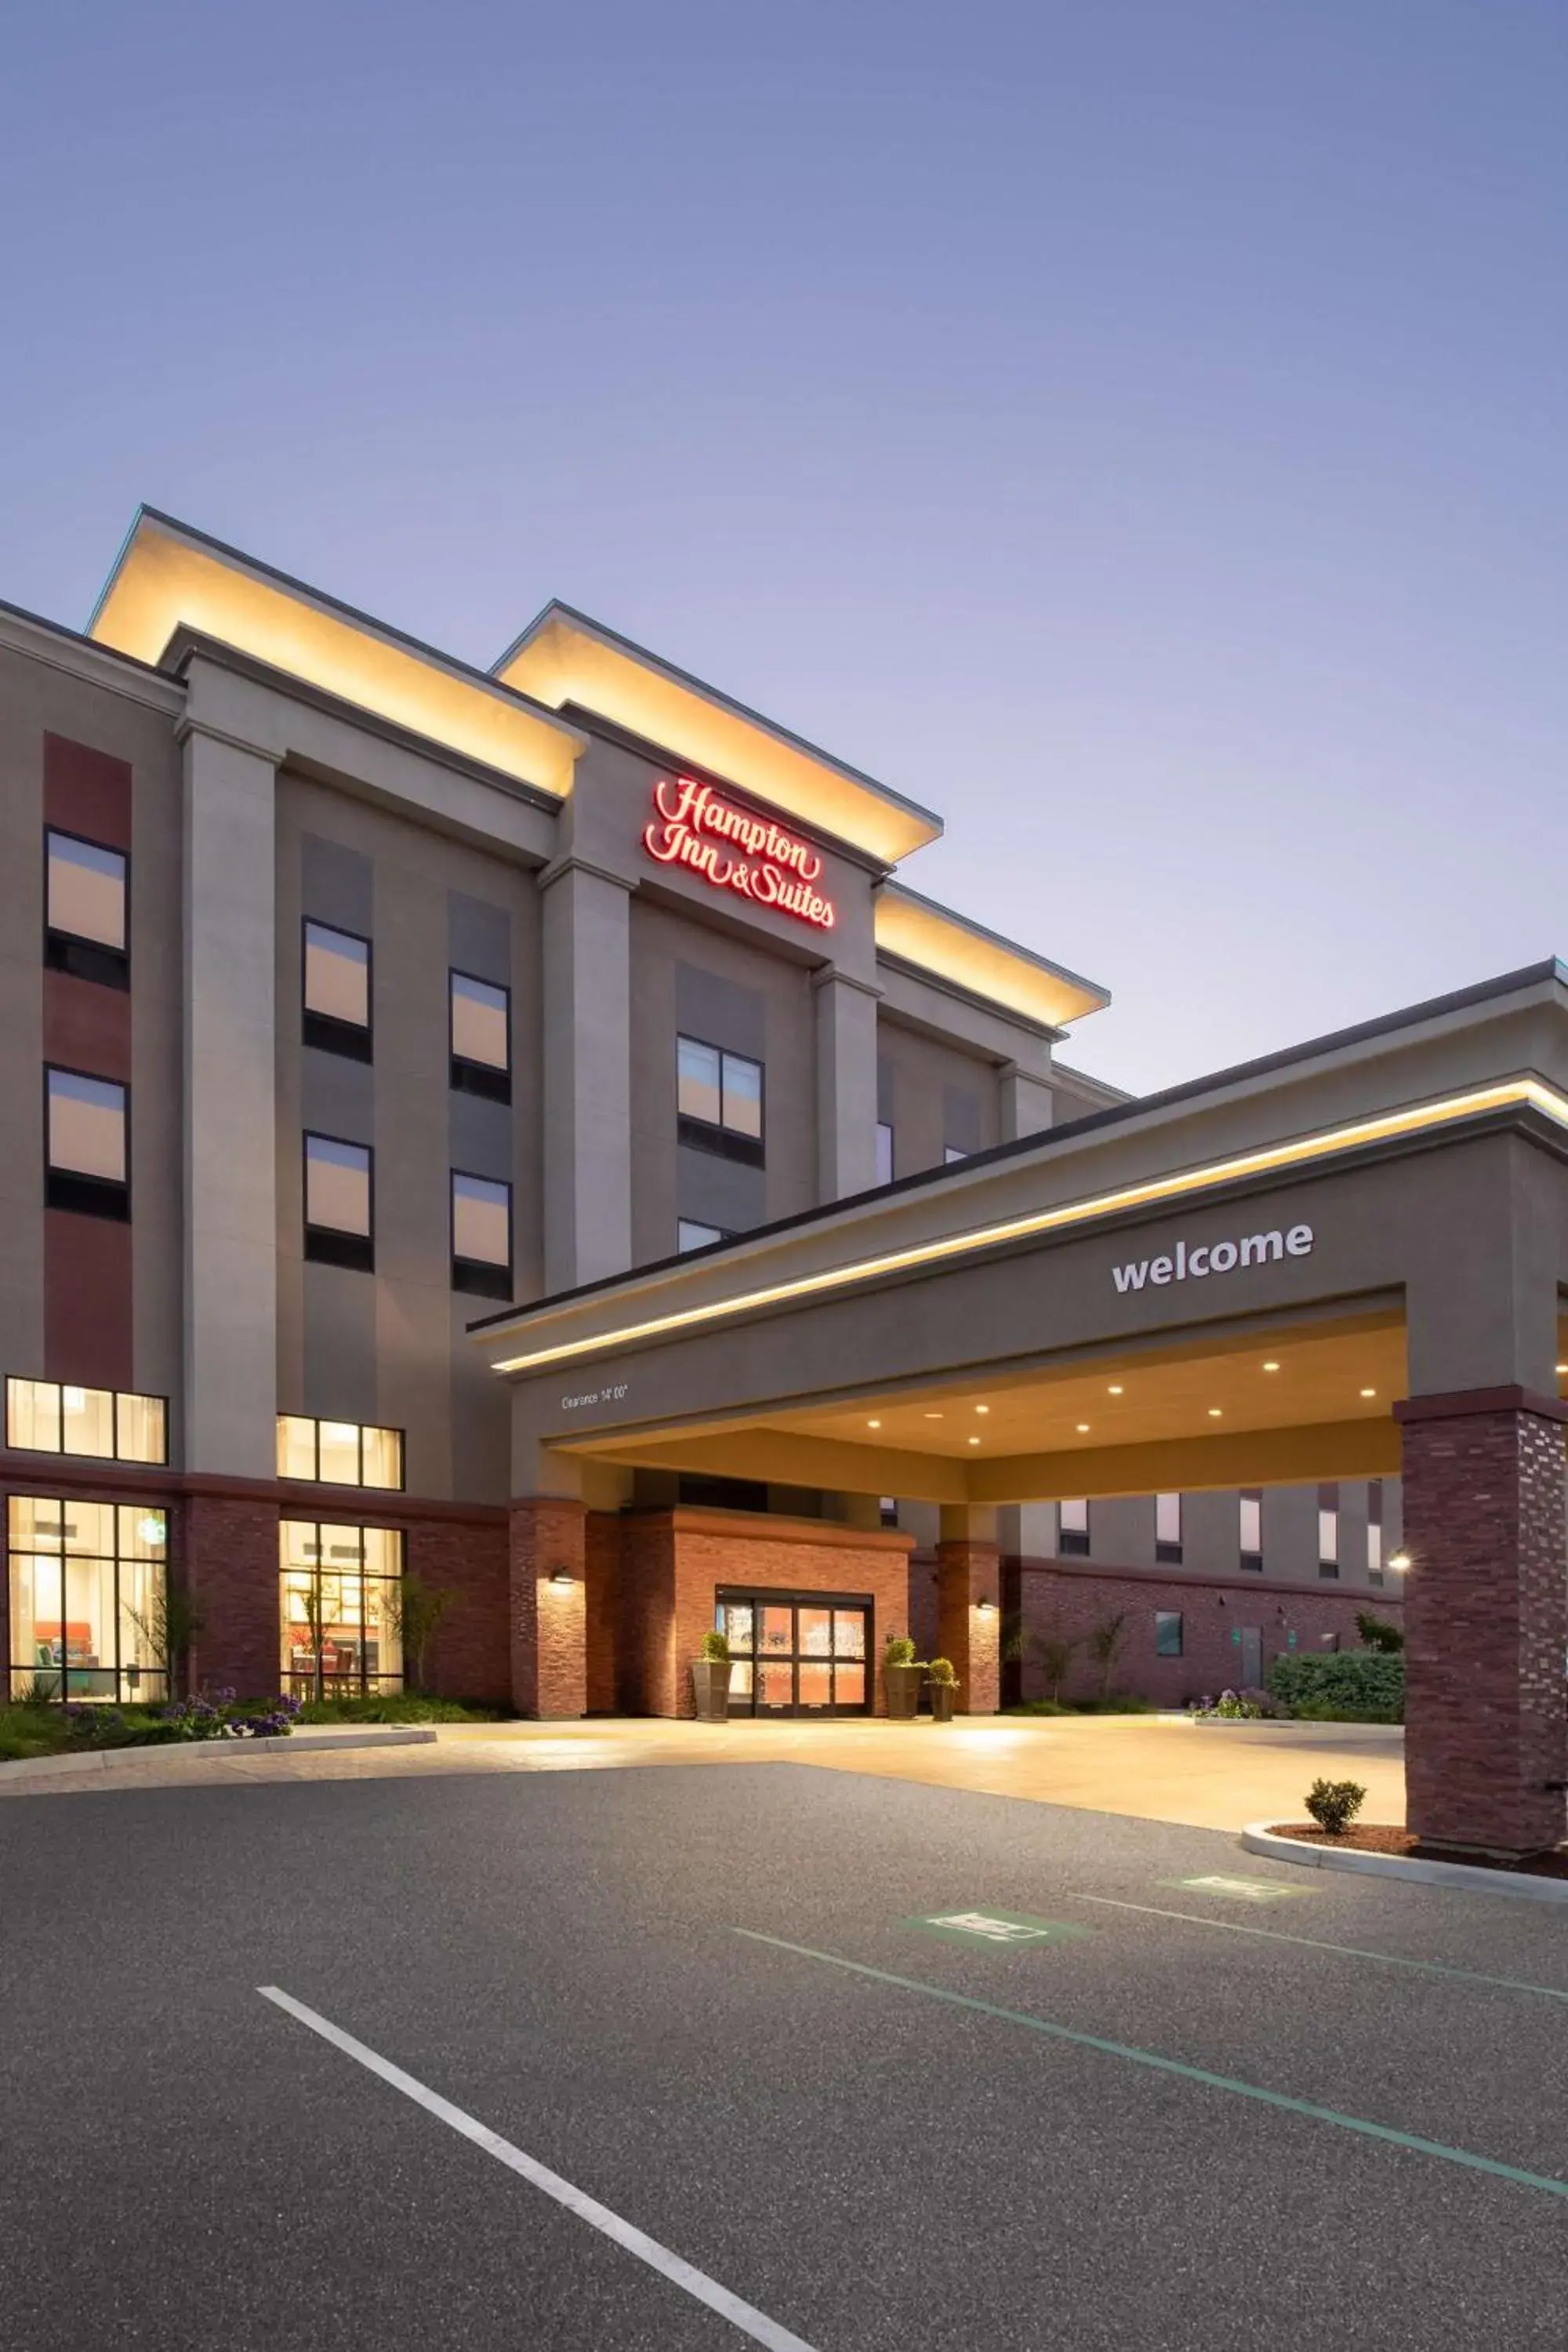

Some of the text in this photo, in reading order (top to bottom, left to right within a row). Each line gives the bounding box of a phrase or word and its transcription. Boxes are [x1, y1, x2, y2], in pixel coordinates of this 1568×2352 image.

[644, 823, 733, 884] Inn
[750, 863, 836, 928] Suites
[655, 778, 820, 880] Hampton
[1111, 1224, 1315, 1294] welcome
